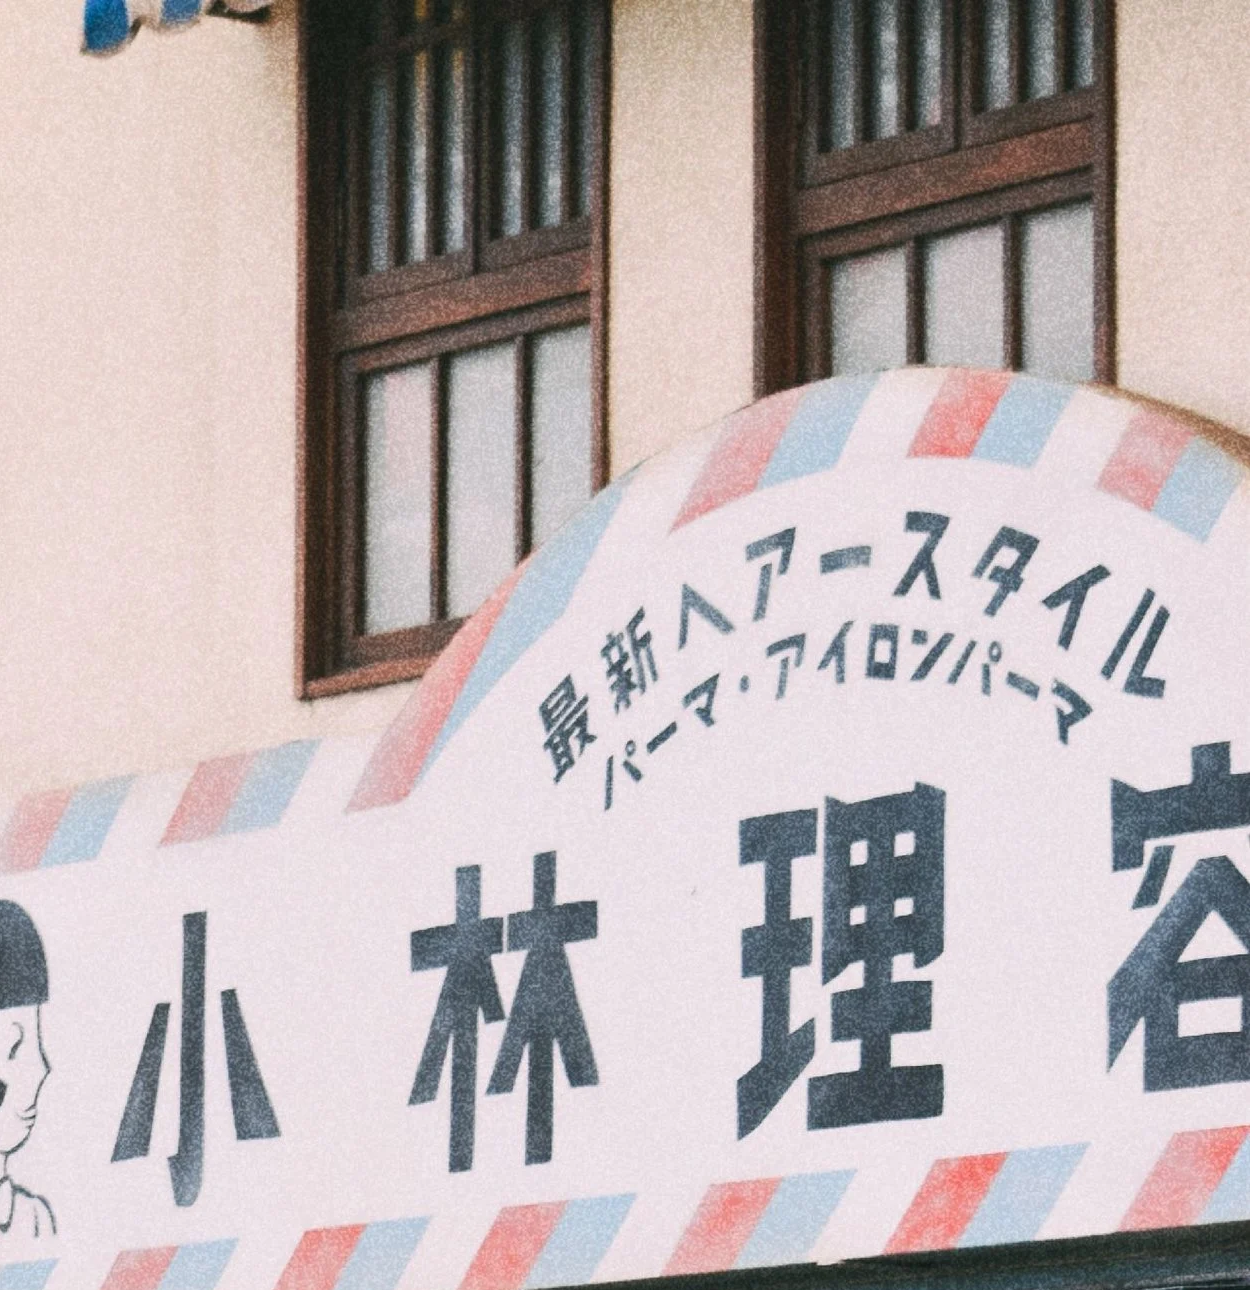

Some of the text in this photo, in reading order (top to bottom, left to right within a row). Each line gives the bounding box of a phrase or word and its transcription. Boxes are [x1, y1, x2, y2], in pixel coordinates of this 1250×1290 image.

[536, 510, 1172, 785] 最新ヘアースタイル
